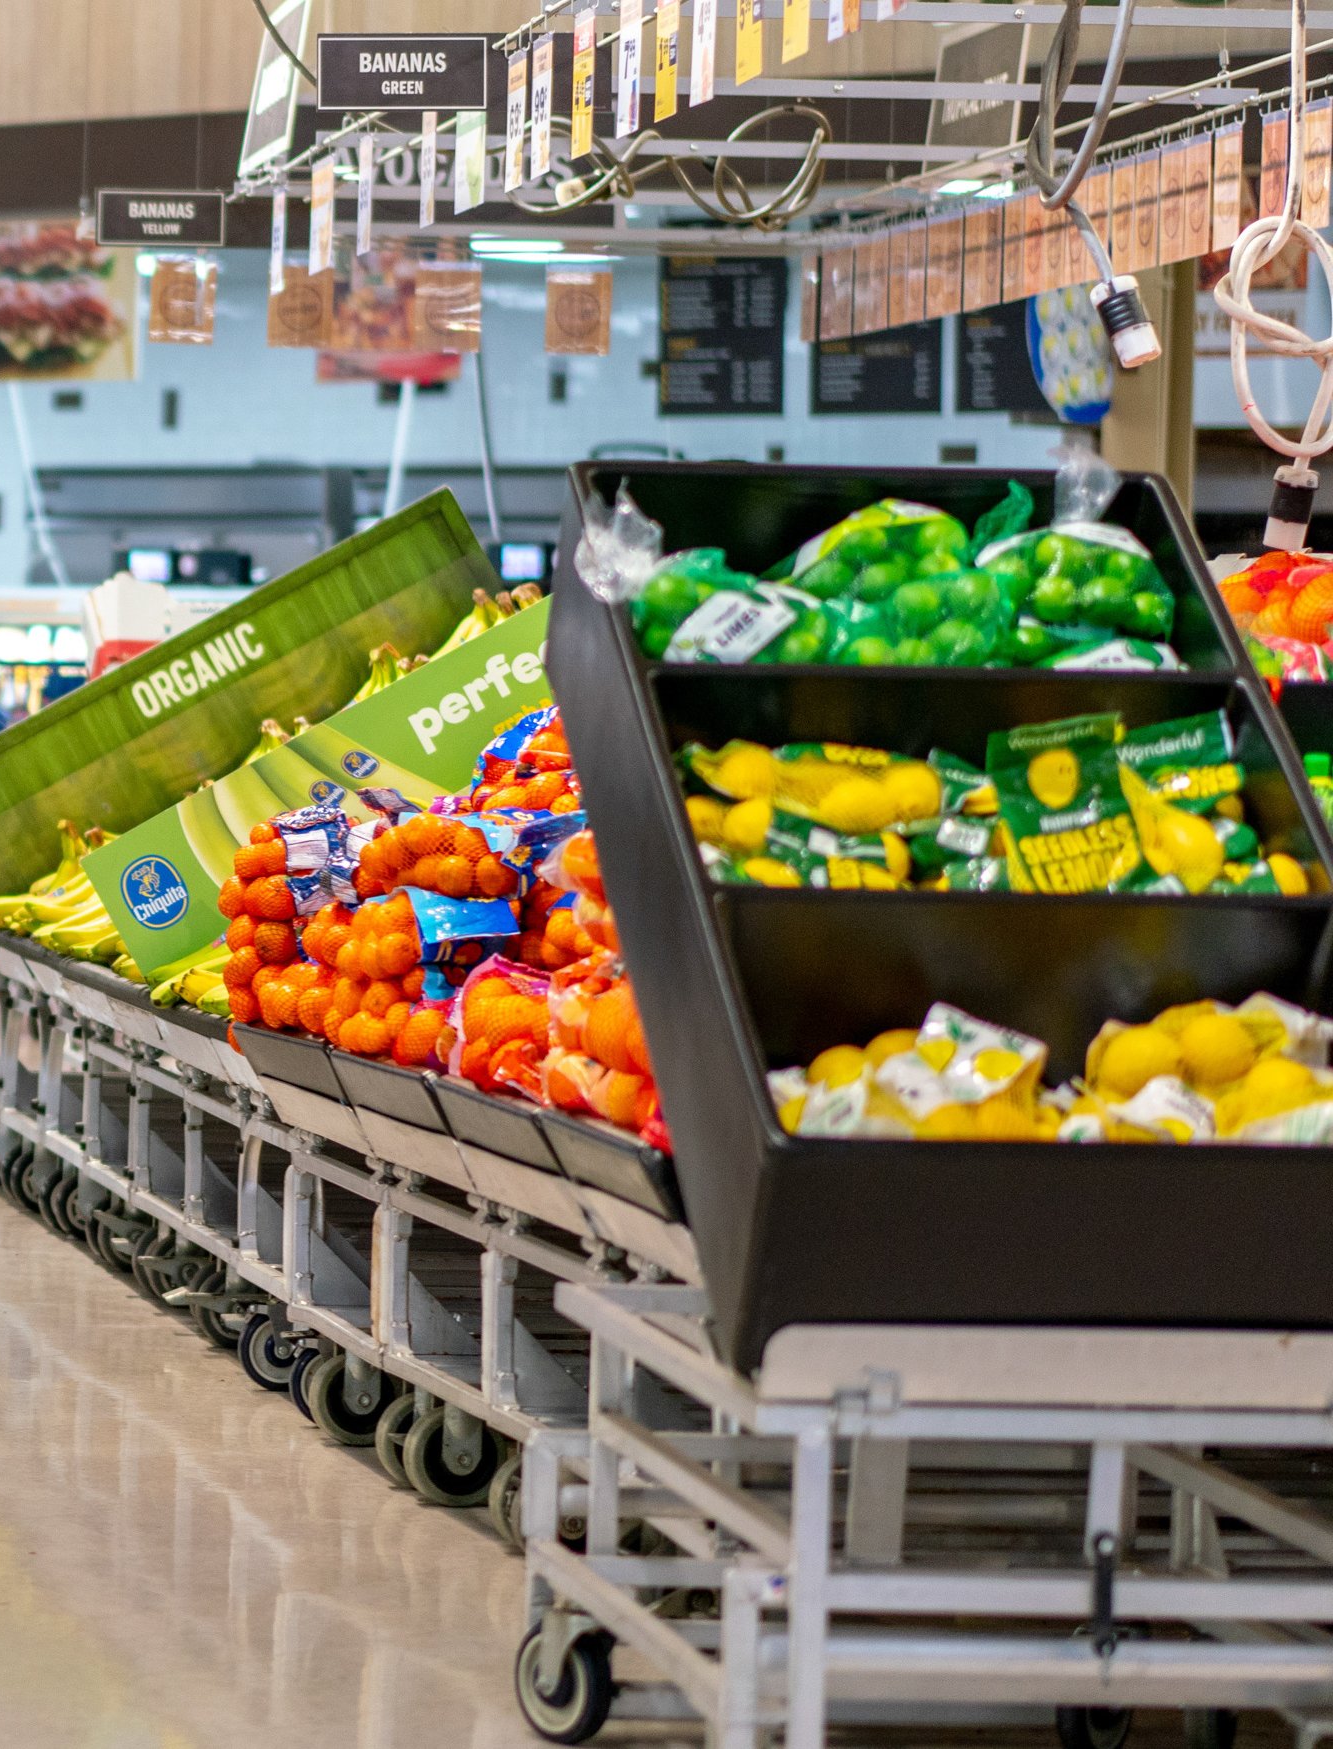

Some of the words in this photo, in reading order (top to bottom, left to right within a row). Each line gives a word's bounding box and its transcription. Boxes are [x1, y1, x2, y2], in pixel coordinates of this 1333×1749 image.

[359, 52, 447, 74] BANANAS
[381, 80, 424, 95] GREEN
[128, 202, 195, 219] BANANAS
[142, 223, 180, 235] YELLOW
[715, 606, 761, 648] LIMES
[131, 622, 265, 718] ORGANIC
[1115, 729, 1205, 763] Wonderful
[133, 884, 188, 922] Chiquita
